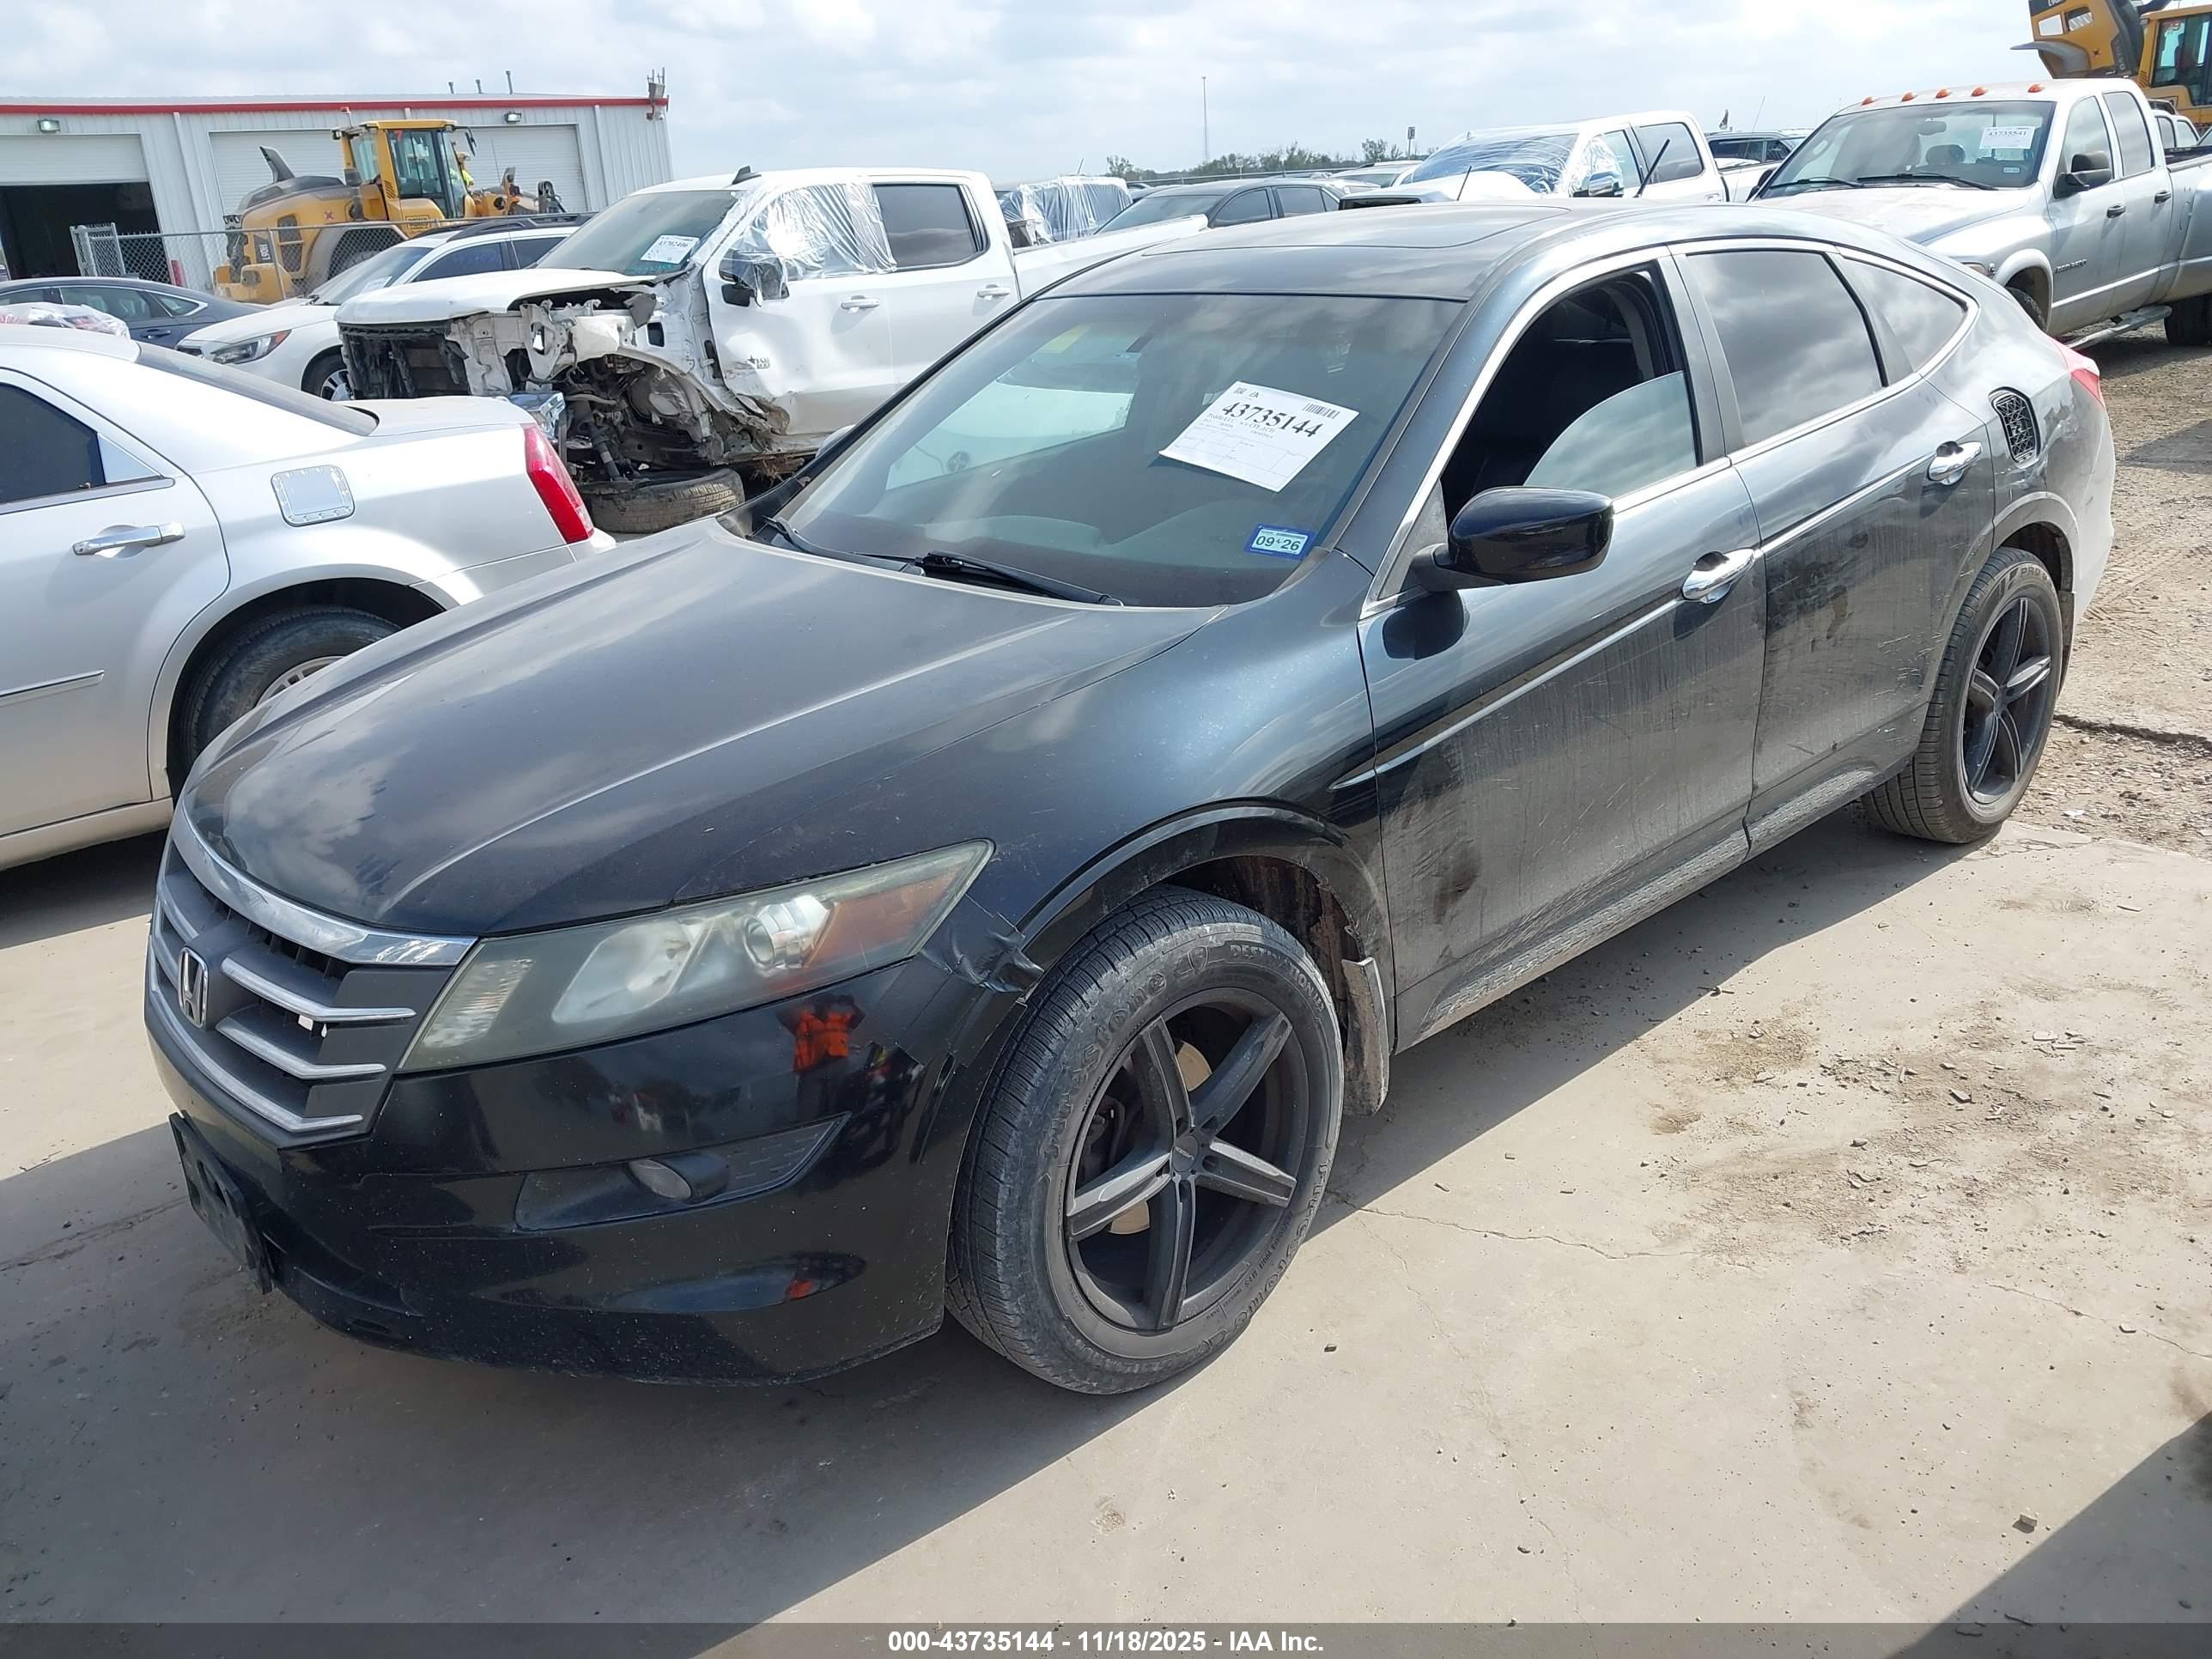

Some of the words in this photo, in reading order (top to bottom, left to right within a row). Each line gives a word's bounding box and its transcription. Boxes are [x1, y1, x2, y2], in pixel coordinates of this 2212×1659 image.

[1222, 402, 1323, 438] 43735144
[1255, 535, 1275, 547] 09
[1280, 539, 1302, 551] 26
